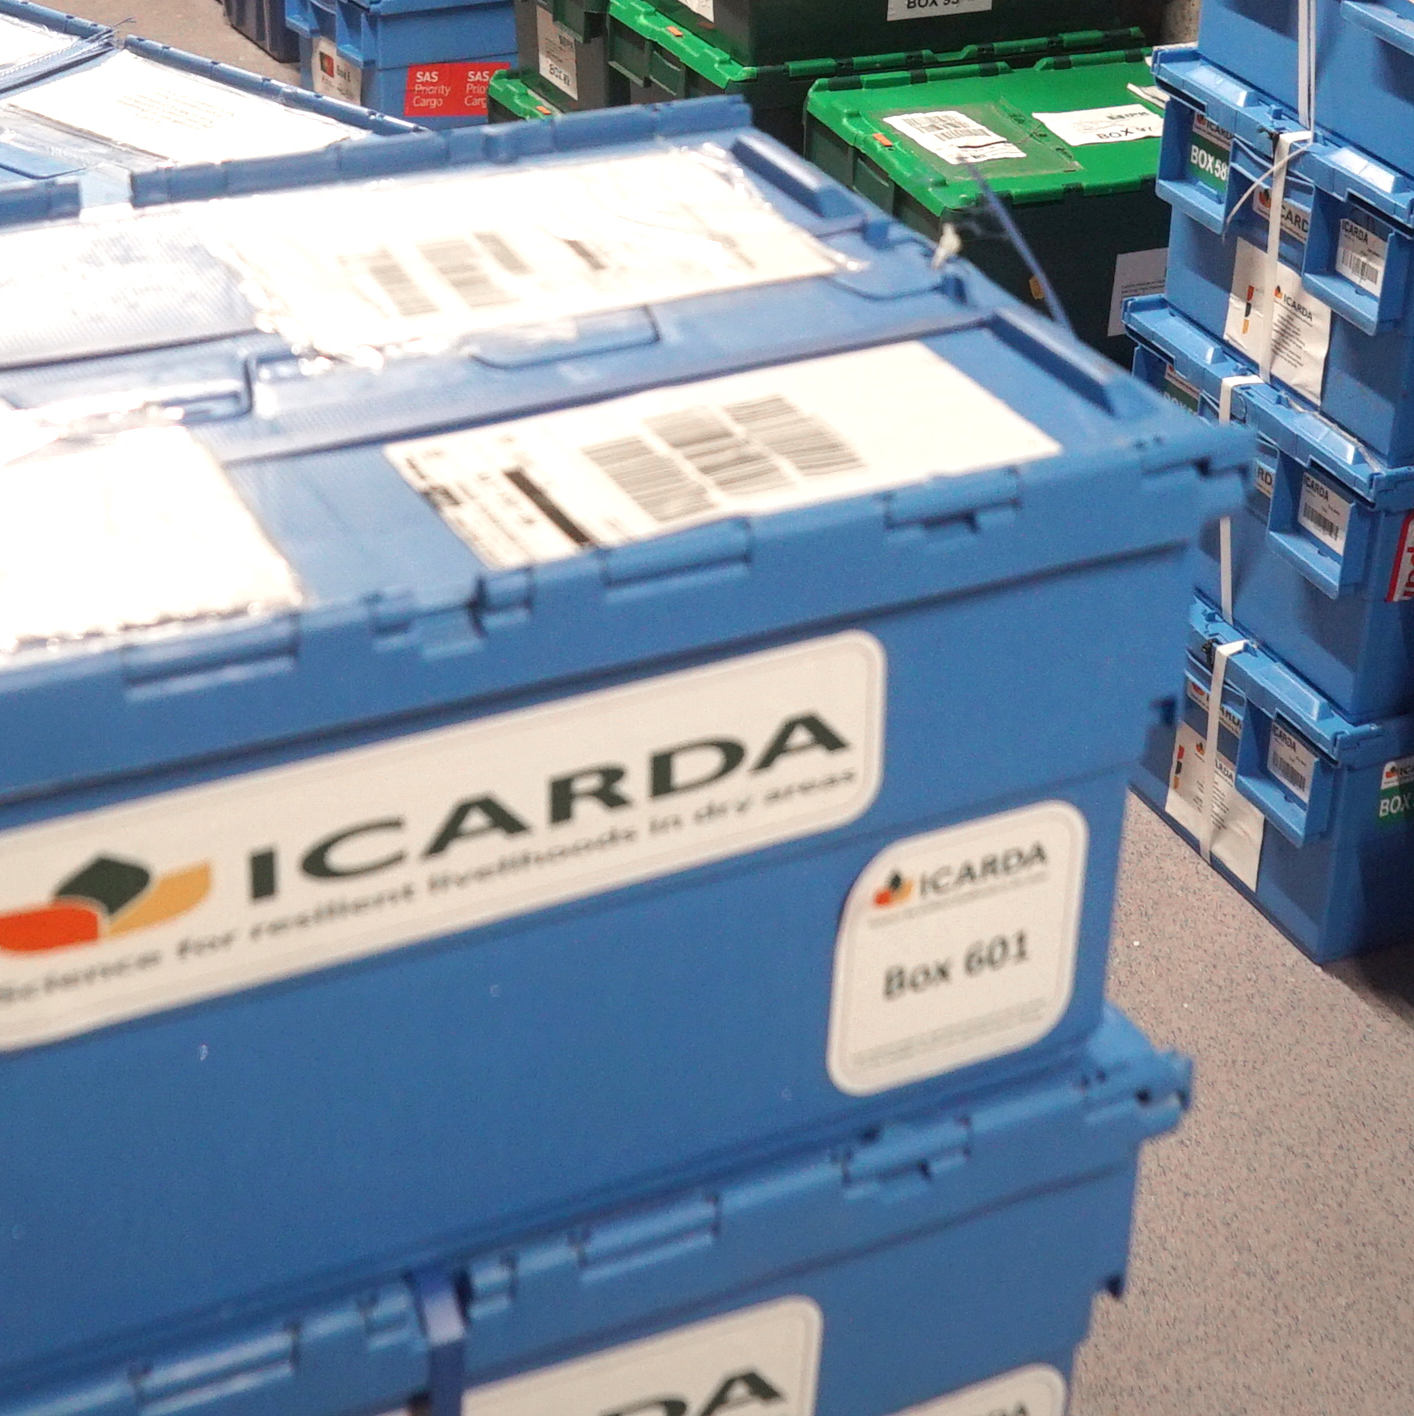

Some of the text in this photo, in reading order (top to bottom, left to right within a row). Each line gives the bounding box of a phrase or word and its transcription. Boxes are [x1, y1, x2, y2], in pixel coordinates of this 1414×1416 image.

[414, 84, 451, 97] Priority
[416, 71, 490, 82] SAS SAS
[413, 96, 487, 109] Cargo Carg
[1096, 127, 1134, 140] BOX
[1191, 144, 1228, 181] BOX 58
[1282, 293, 1313, 323] ICARDA
[248, 710, 850, 904] ICARDA
[1379, 795, 1407, 818] BOX
[177, 932, 236, 964] for
[247, 882, 417, 944] resilient
[425, 827, 639, 896] livelihoods
[647, 810, 682, 836] in
[694, 796, 754, 827] dry
[762, 768, 857, 808] areas
[918, 842, 1048, 898] ICARDA
[883, 929, 1029, 1002] Box 601
